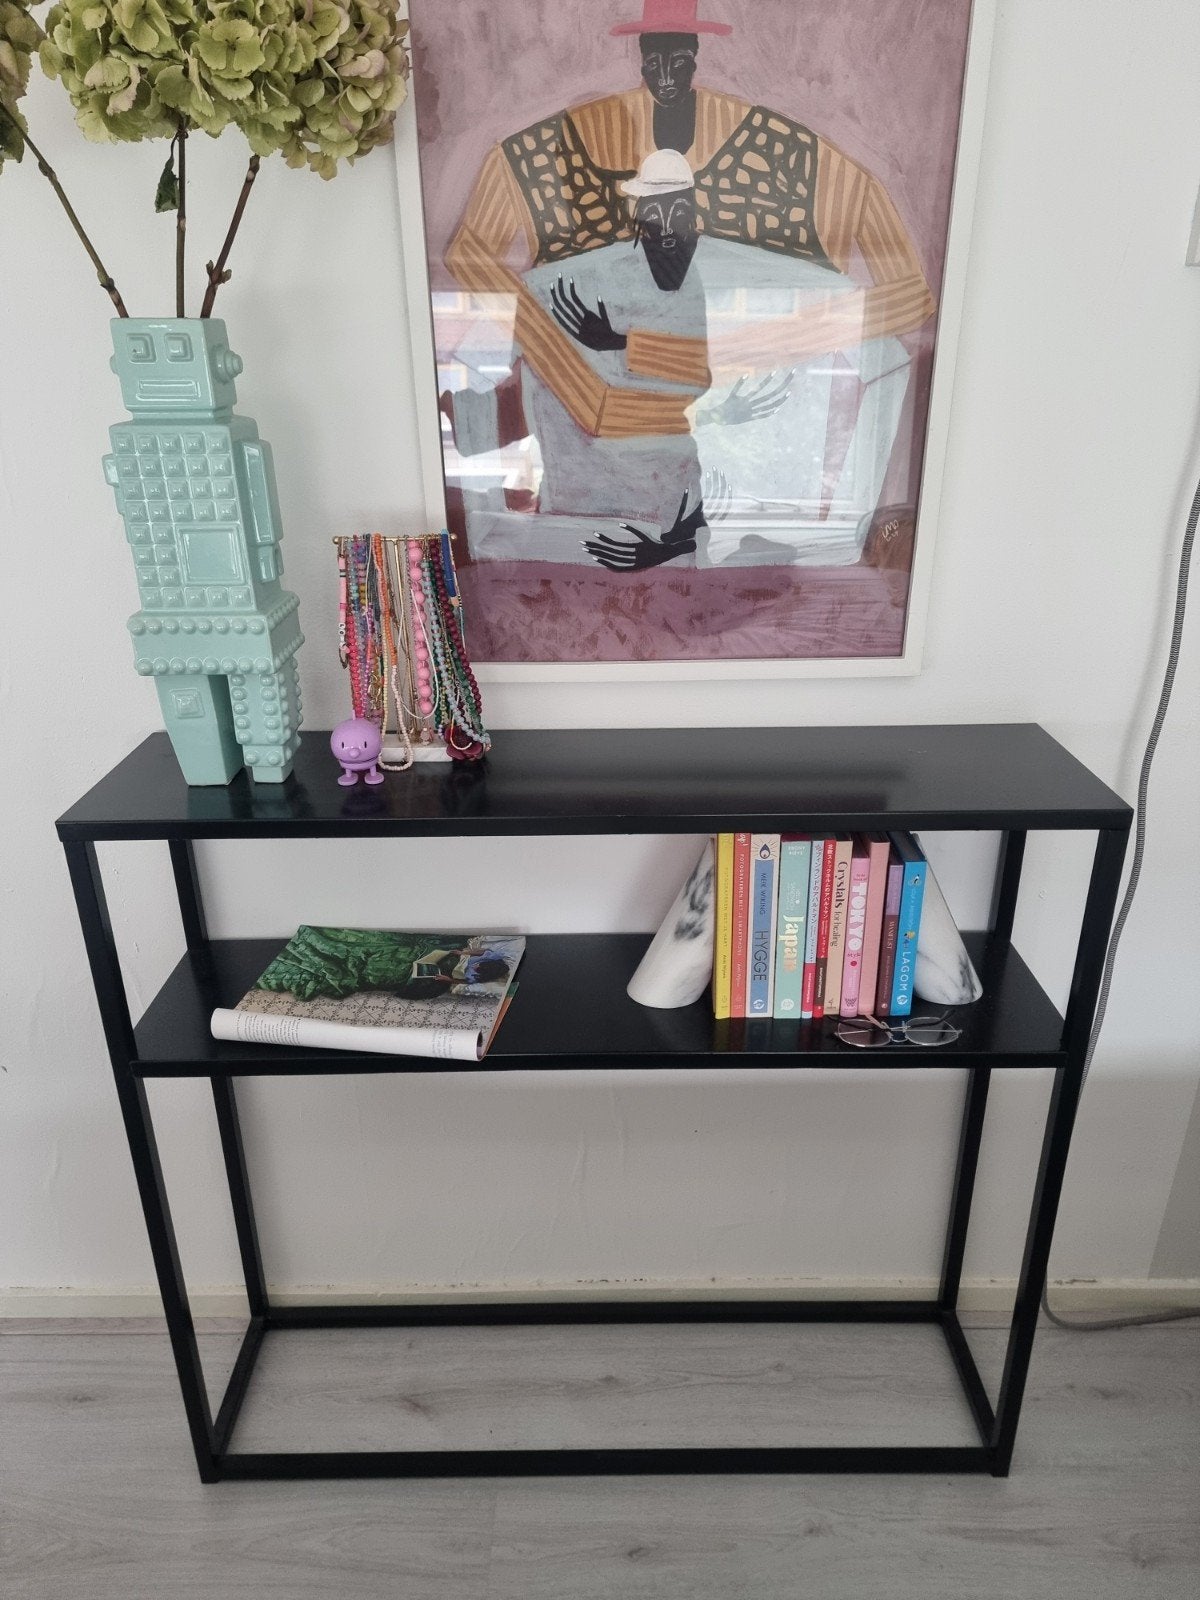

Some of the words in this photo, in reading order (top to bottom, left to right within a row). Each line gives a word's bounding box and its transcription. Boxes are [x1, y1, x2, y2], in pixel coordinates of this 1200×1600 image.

[759, 890, 767, 916] WIKING
[834, 861, 849, 909] Crystals
[830, 921, 842, 948] healing
[833, 911, 842, 921] for
[848, 881, 867, 951] TOKYO
[753, 930, 769, 981] HYGGE
[778, 914, 804, 974] Japan
[899, 951, 912, 991] LAGOM
